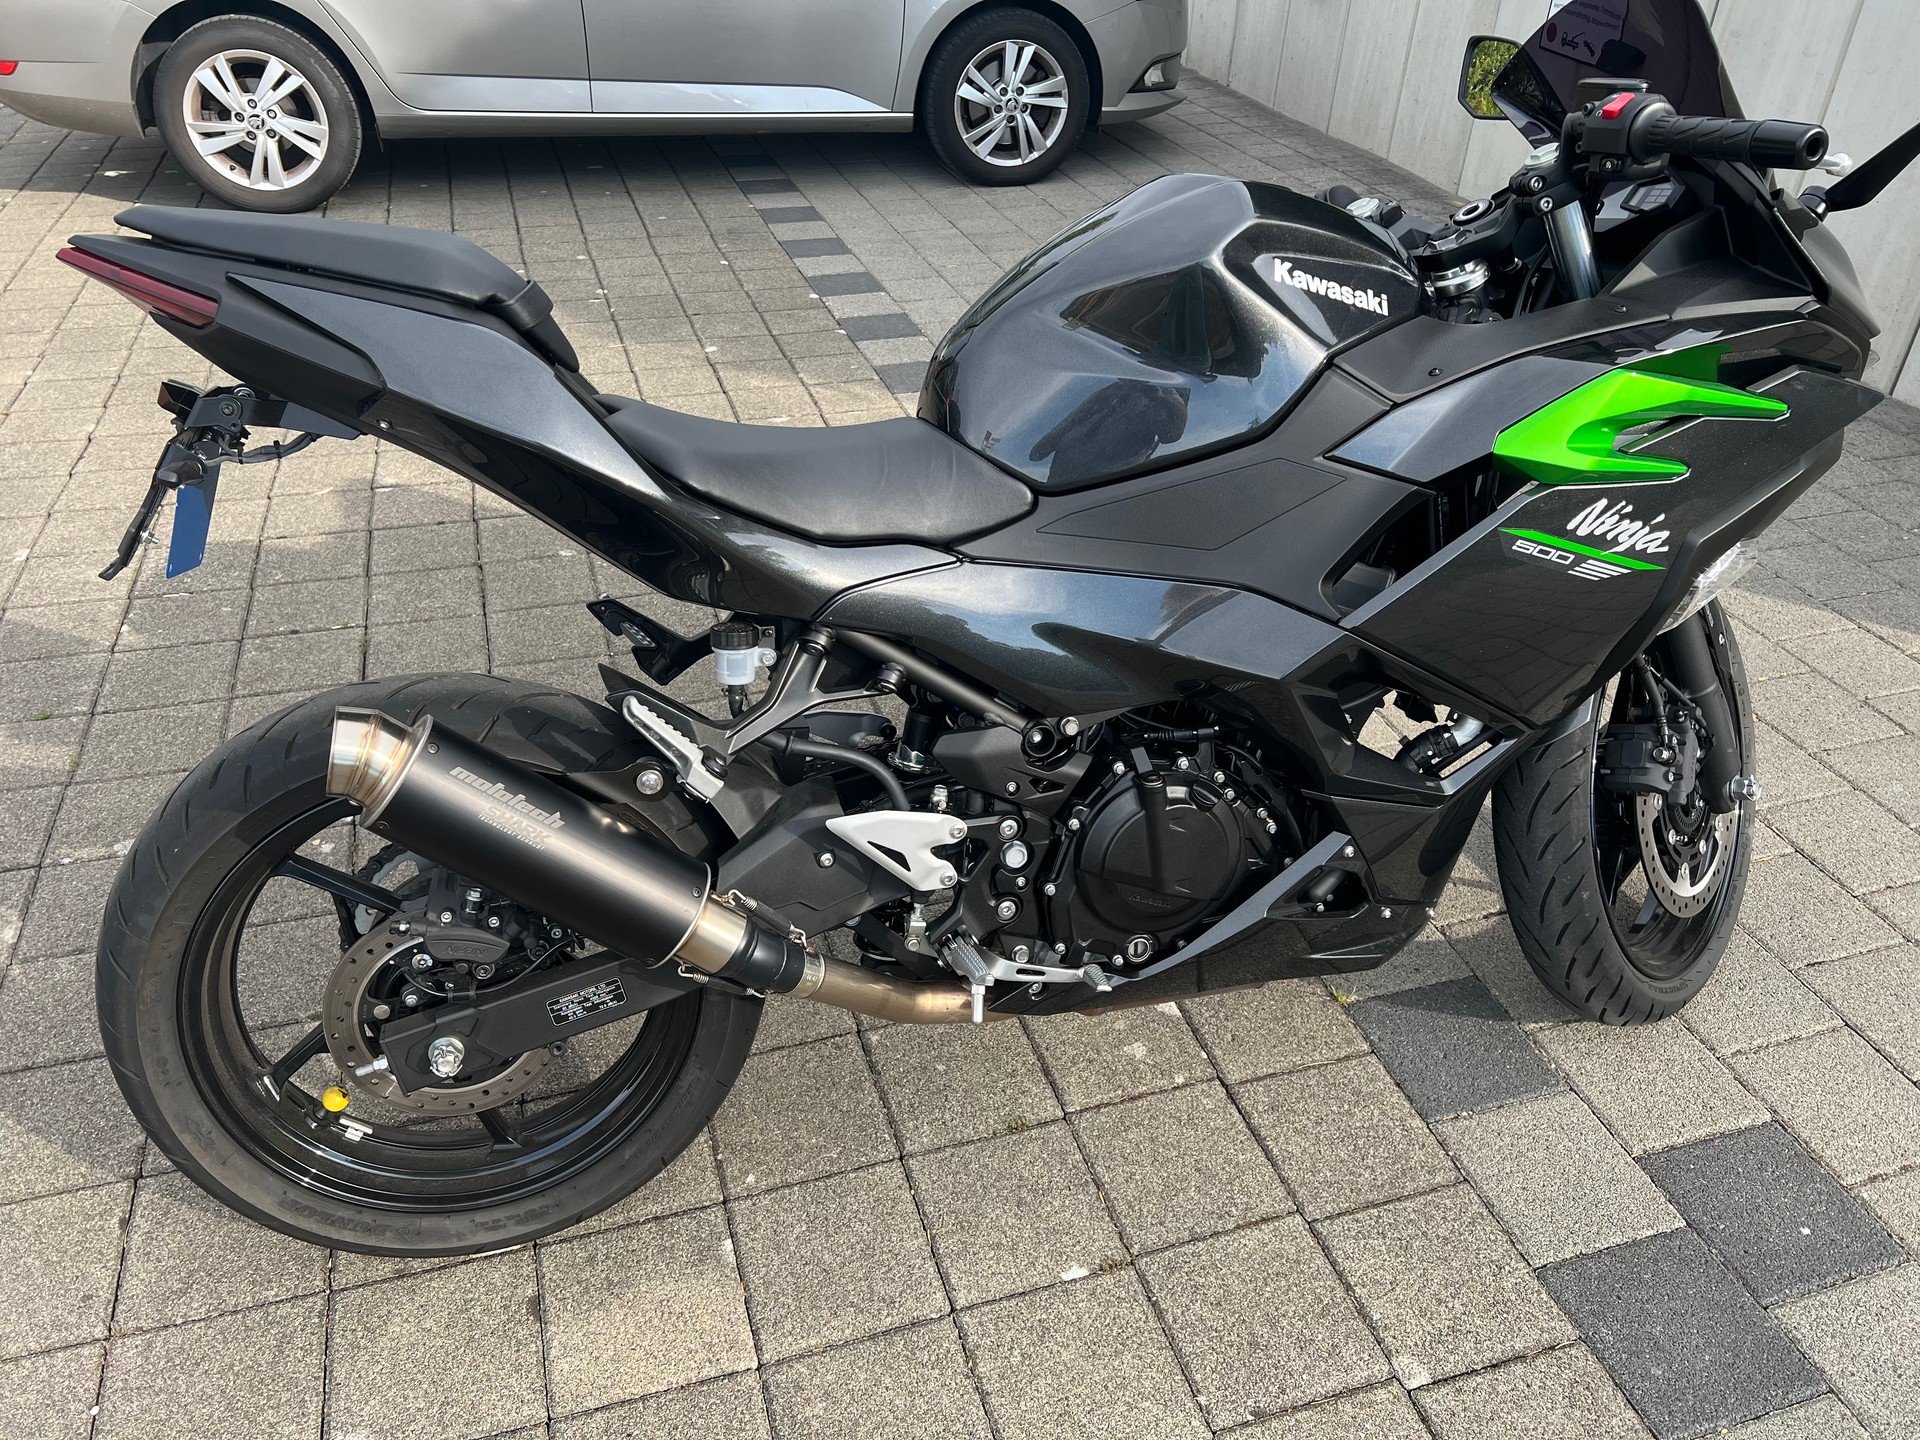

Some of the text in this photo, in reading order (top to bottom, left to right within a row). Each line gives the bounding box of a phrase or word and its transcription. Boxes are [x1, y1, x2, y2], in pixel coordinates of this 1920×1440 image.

[1273, 257, 1390, 317] Kawasaki
[1566, 497, 1671, 557] Ninja
[1511, 539, 1576, 566] 500
[477, 813, 545, 851] TECHNOLOGY EXHAUST
[483, 804, 553, 845] SHARK
